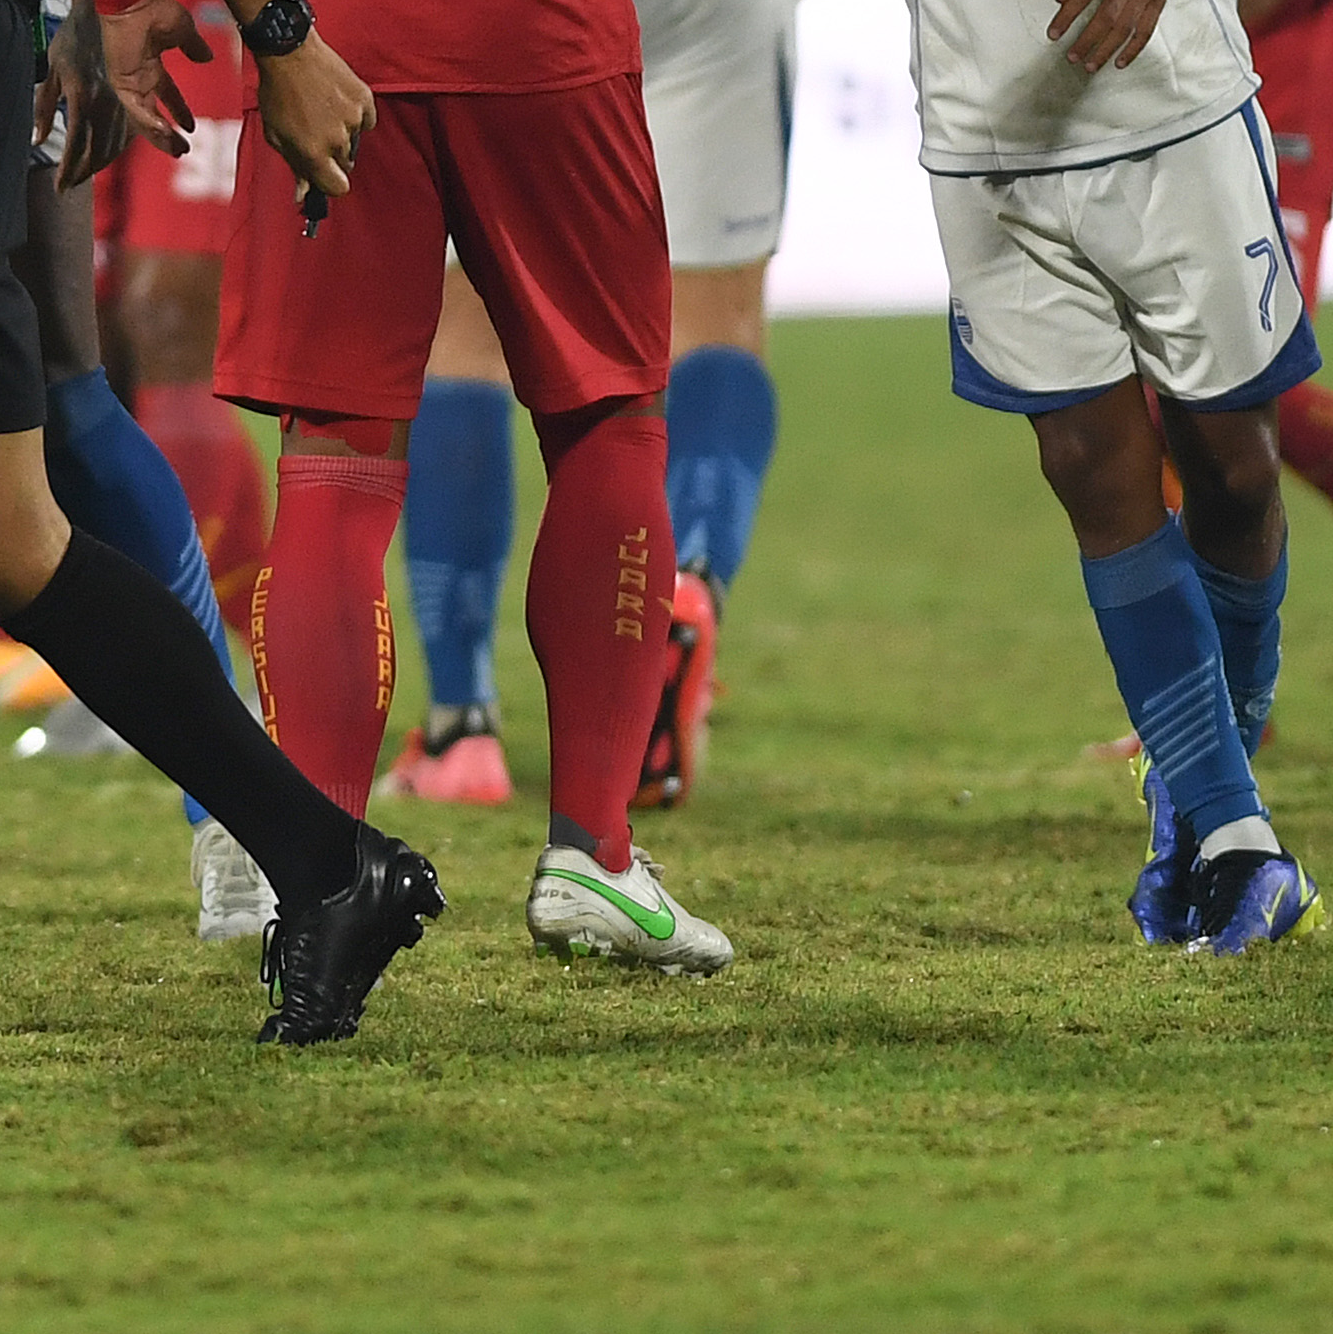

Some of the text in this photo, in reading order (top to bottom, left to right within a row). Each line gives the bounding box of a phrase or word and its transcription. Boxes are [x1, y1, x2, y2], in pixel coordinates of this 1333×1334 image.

[1244, 236, 1278, 333] 7
[251, 566, 280, 747] PERSIJA
[374, 589, 393, 713] JUARA
